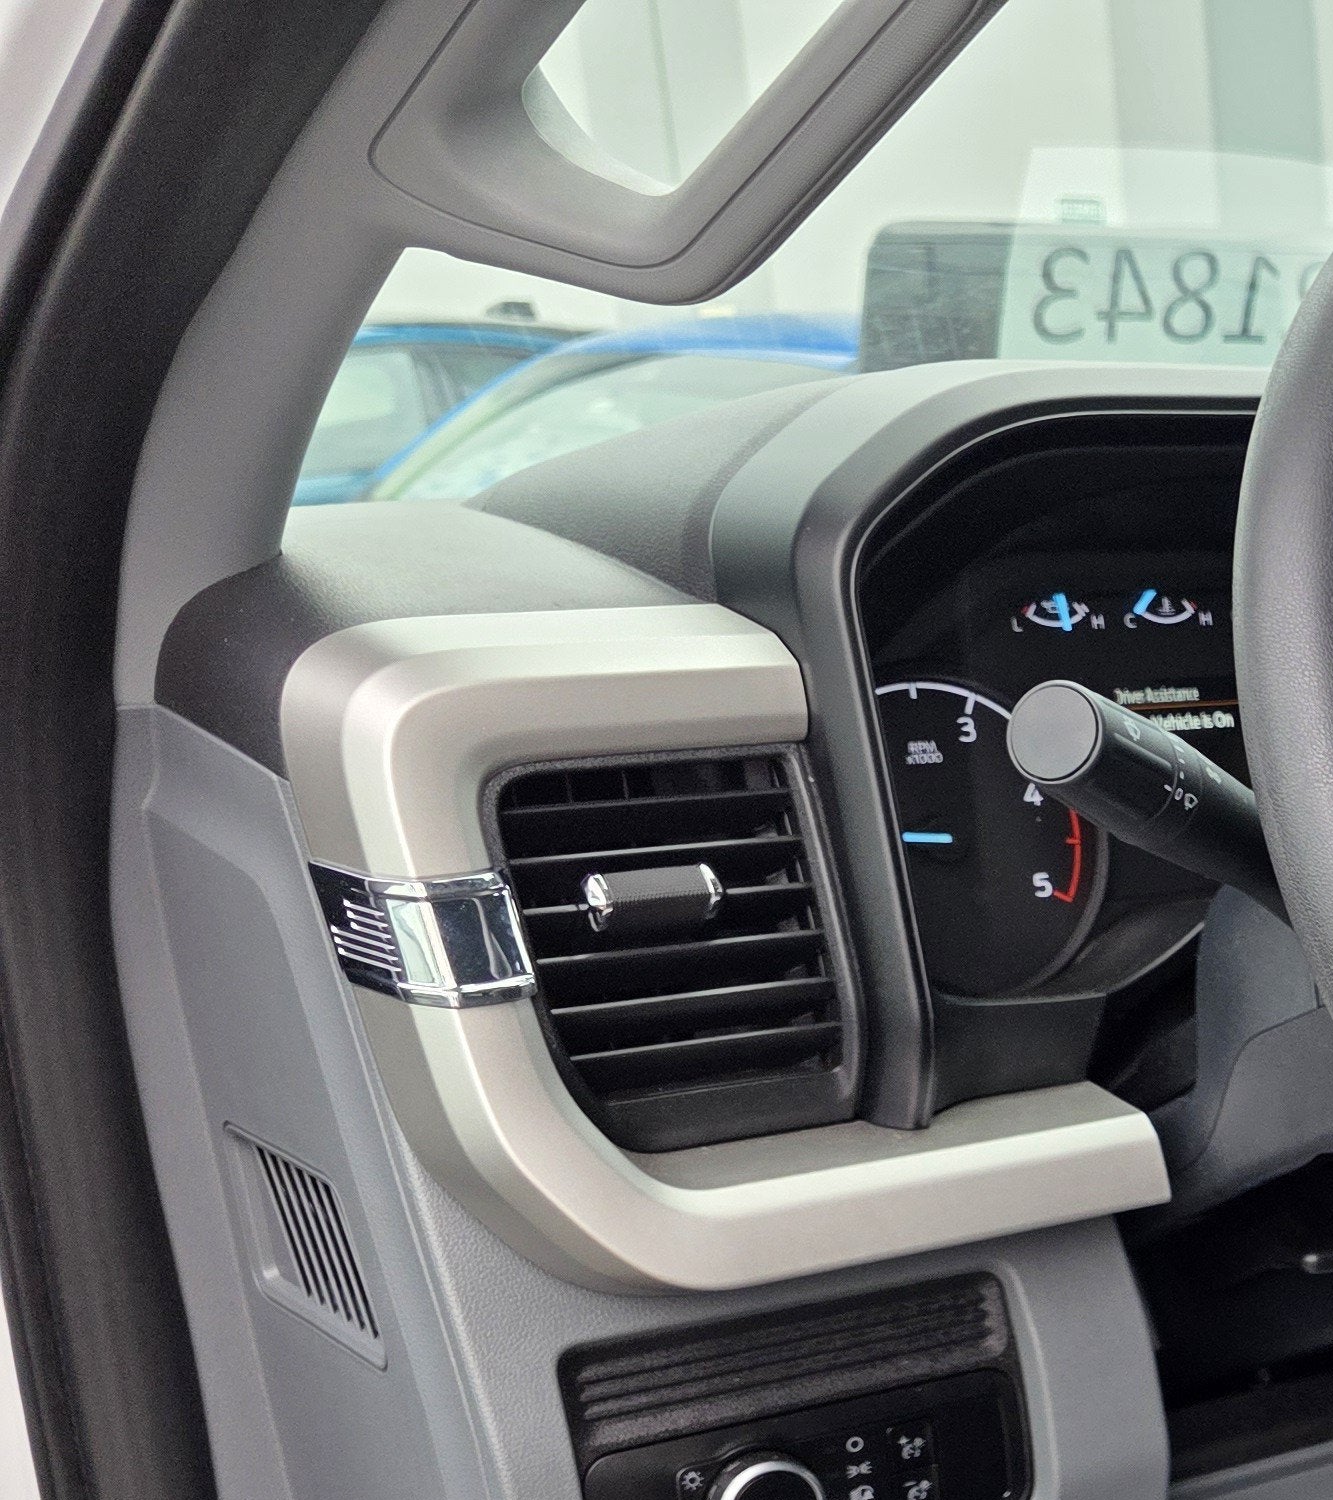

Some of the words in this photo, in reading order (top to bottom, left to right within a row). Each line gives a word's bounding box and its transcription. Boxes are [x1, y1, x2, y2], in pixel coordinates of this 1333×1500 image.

[1090, 613, 1106, 630] H
[1123, 613, 1138, 629] C
[1198, 610, 1214, 627] H
[956, 716, 978, 743] 3
[907, 739, 938, 754] RPM
[1023, 782, 1044, 807] 4
[1032, 871, 1053, 898] 5
